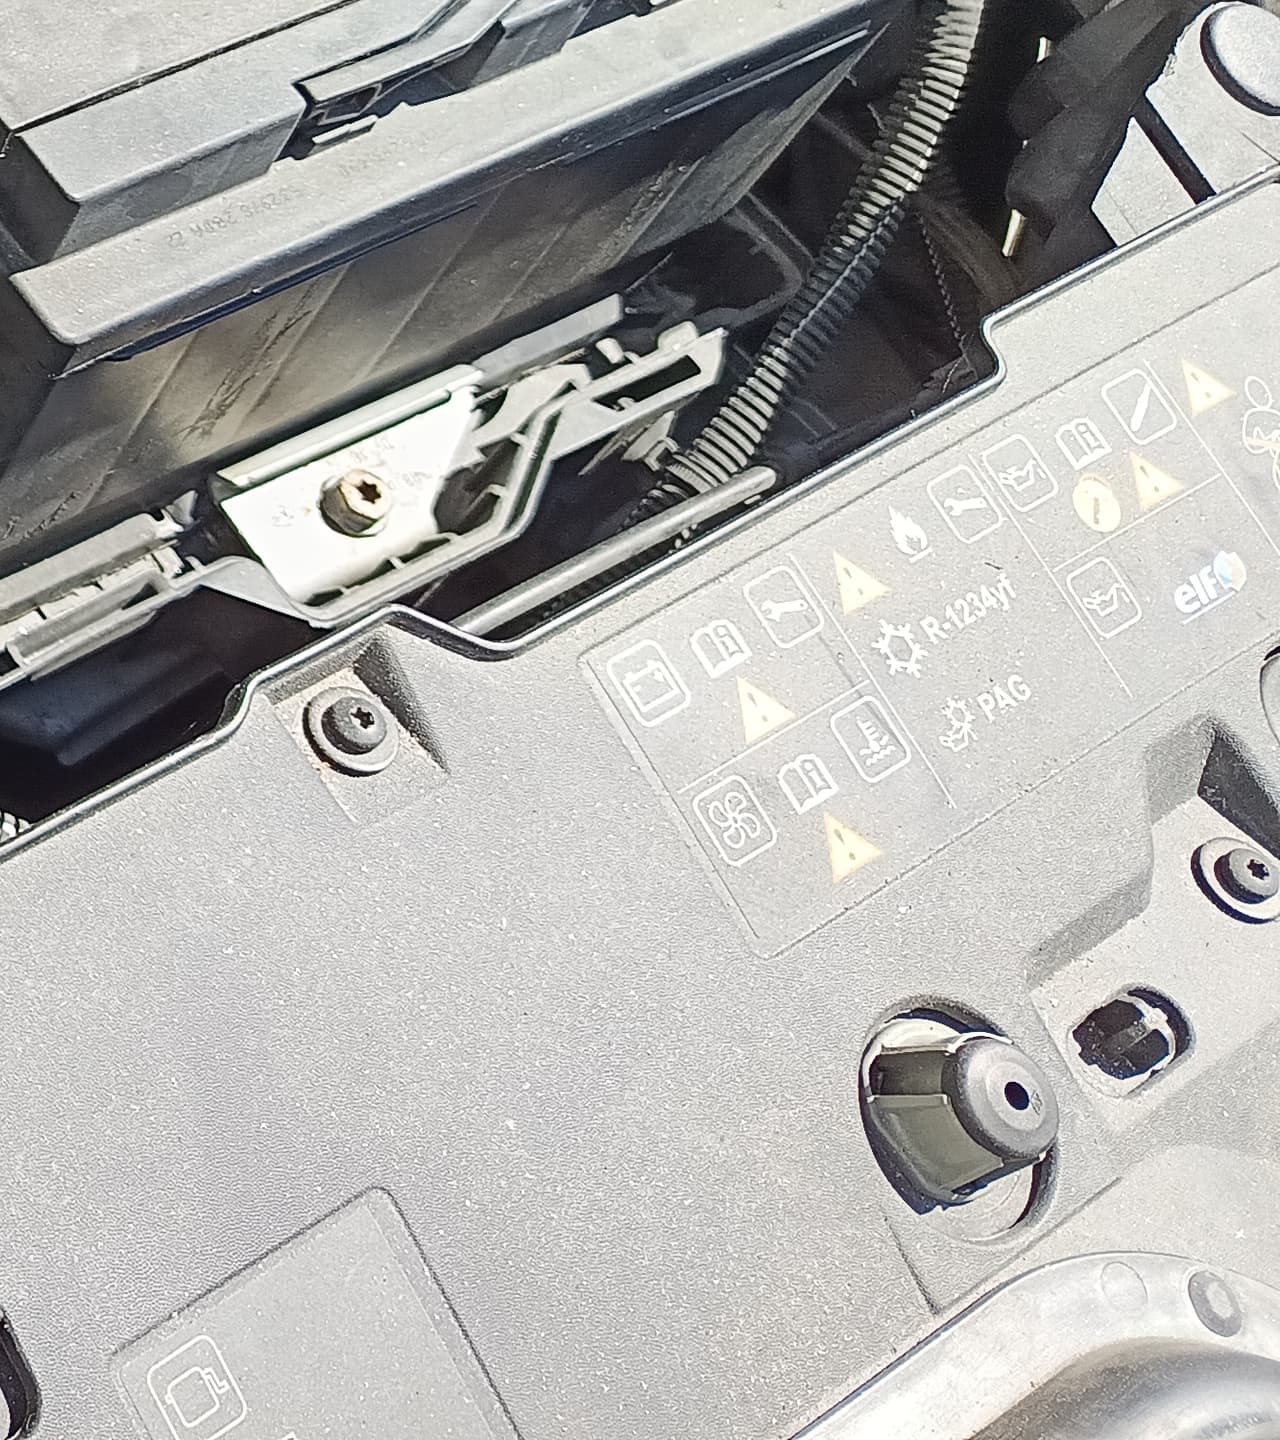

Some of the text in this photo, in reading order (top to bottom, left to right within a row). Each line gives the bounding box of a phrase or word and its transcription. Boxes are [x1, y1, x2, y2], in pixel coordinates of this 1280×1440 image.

[919, 573, 1017, 645] R-1234yf
[1174, 565, 1218, 614] elf
[977, 674, 1032, 724] PAG
